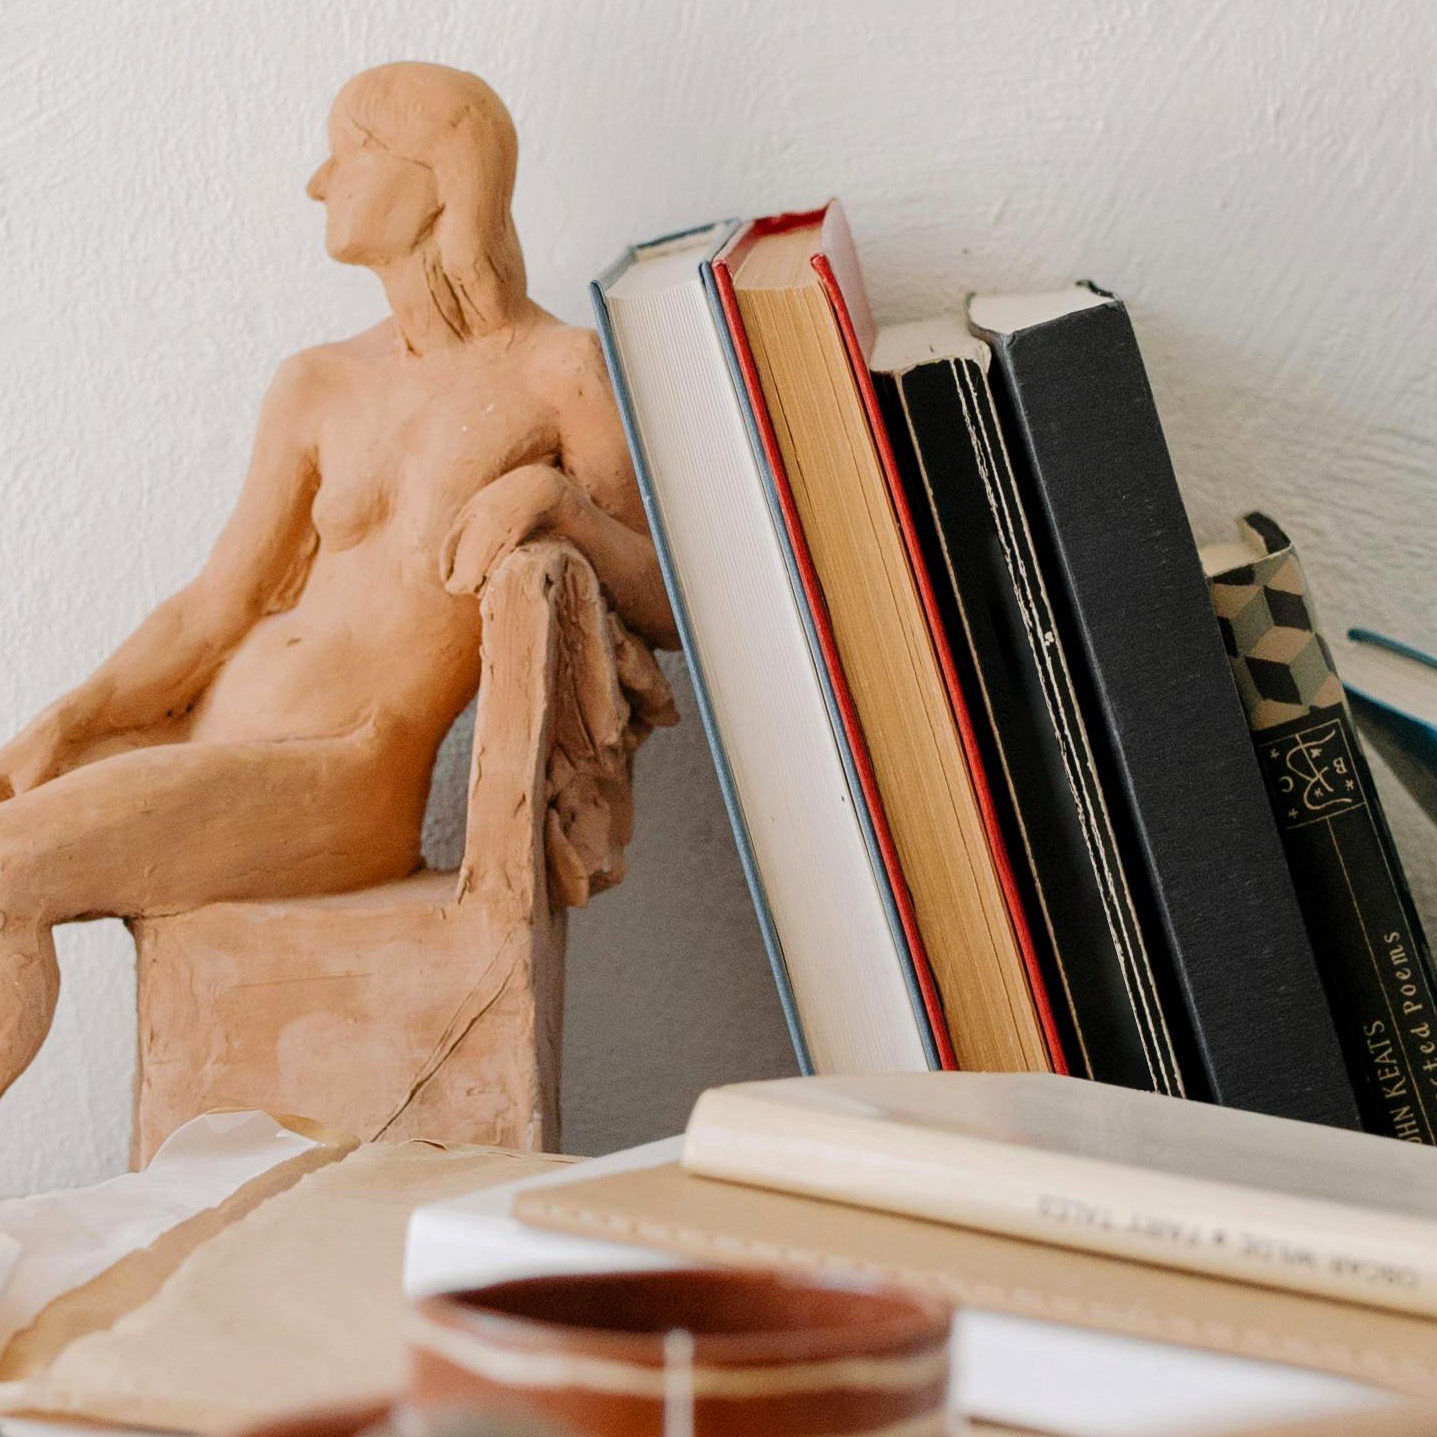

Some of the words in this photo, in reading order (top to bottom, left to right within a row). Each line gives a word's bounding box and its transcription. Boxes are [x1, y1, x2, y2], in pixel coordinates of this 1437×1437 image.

[1384, 931, 1423, 1015] Poems
[1363, 1019, 1407, 1099] KEATS
[1037, 1193, 1115, 1231] TALES
[1128, 1212, 1203, 1247] FAIRY
[1240, 1231, 1315, 1274] WILDE
[1330, 1252, 1421, 1292] OSCAR
